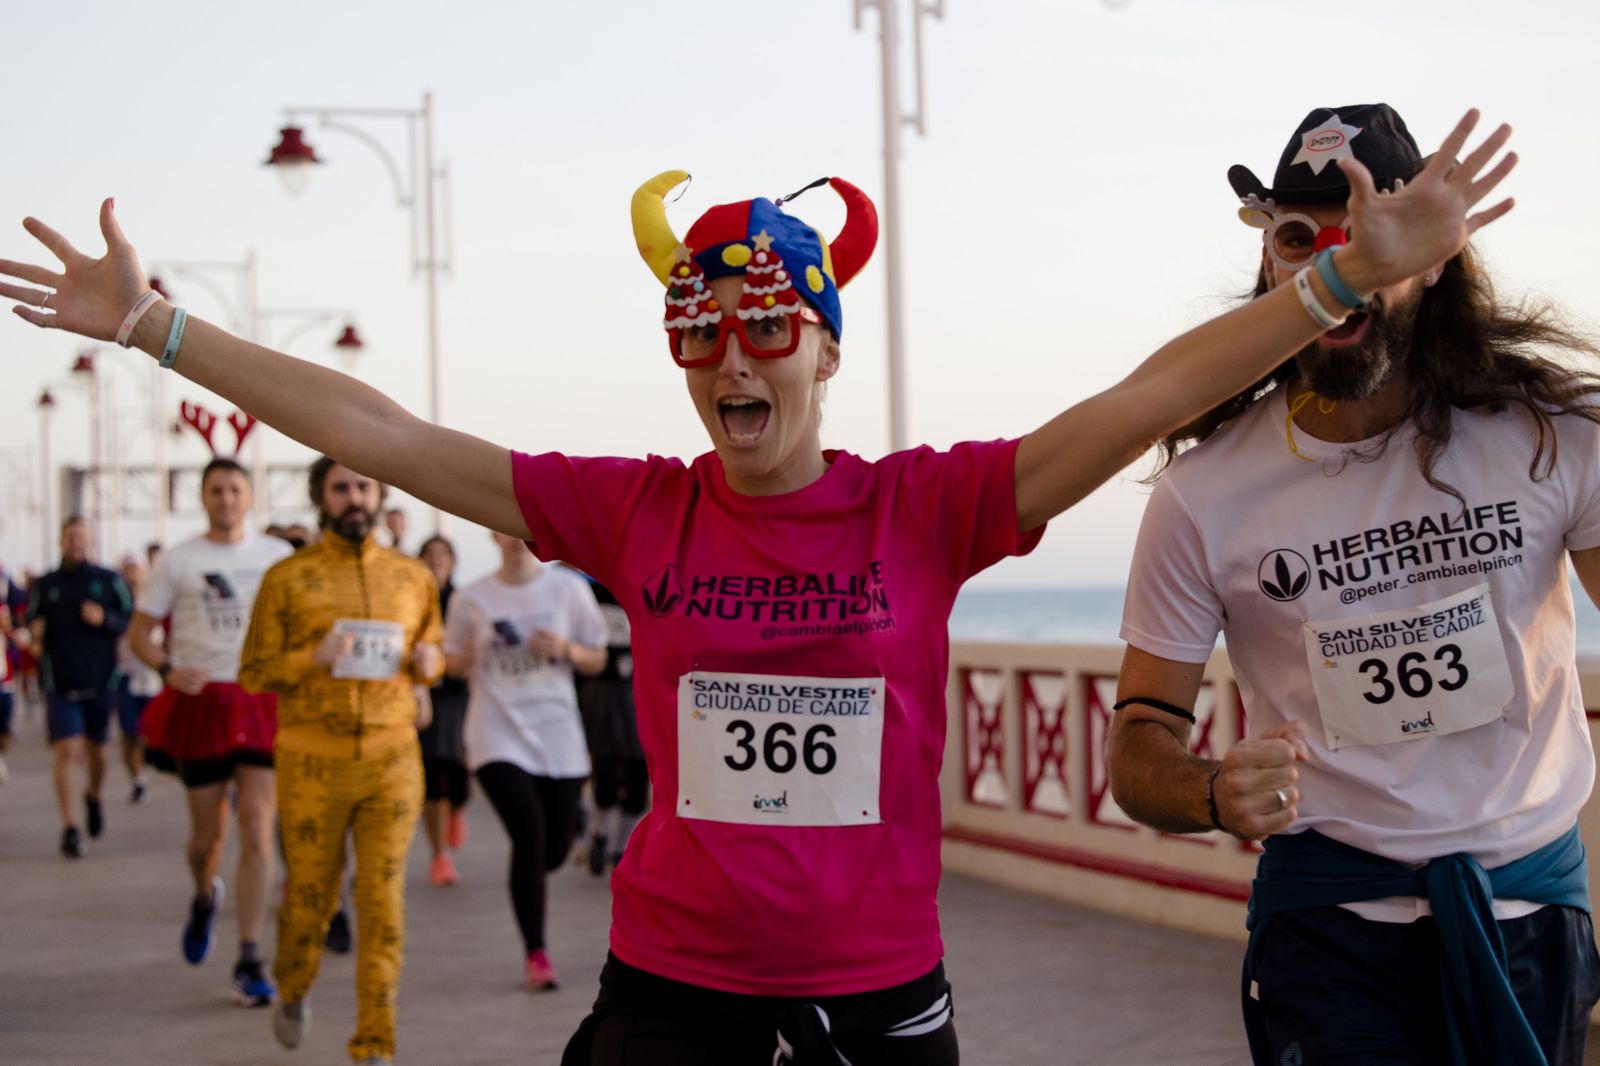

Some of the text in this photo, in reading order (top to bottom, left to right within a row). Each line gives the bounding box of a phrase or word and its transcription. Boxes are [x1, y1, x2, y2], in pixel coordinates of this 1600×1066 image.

[1312, 501, 1520, 566] HERBALIFE
[1318, 526, 1523, 591] NUTRITION
[1340, 553, 1523, 605] @peter_cambiaelpiñon
[684, 587, 889, 622] NUTRITION
[1318, 598, 1482, 643] SAN SILVESTRE
[1322, 633, 1397, 657] CIUDAD
[1402, 631, 1428, 646] DE
[694, 680, 870, 699] SAN SILVESTRE
[1358, 643, 1469, 704] 363
[694, 693, 771, 712] CIUDAD
[779, 698, 804, 714] DE
[724, 719, 838, 775] 366
